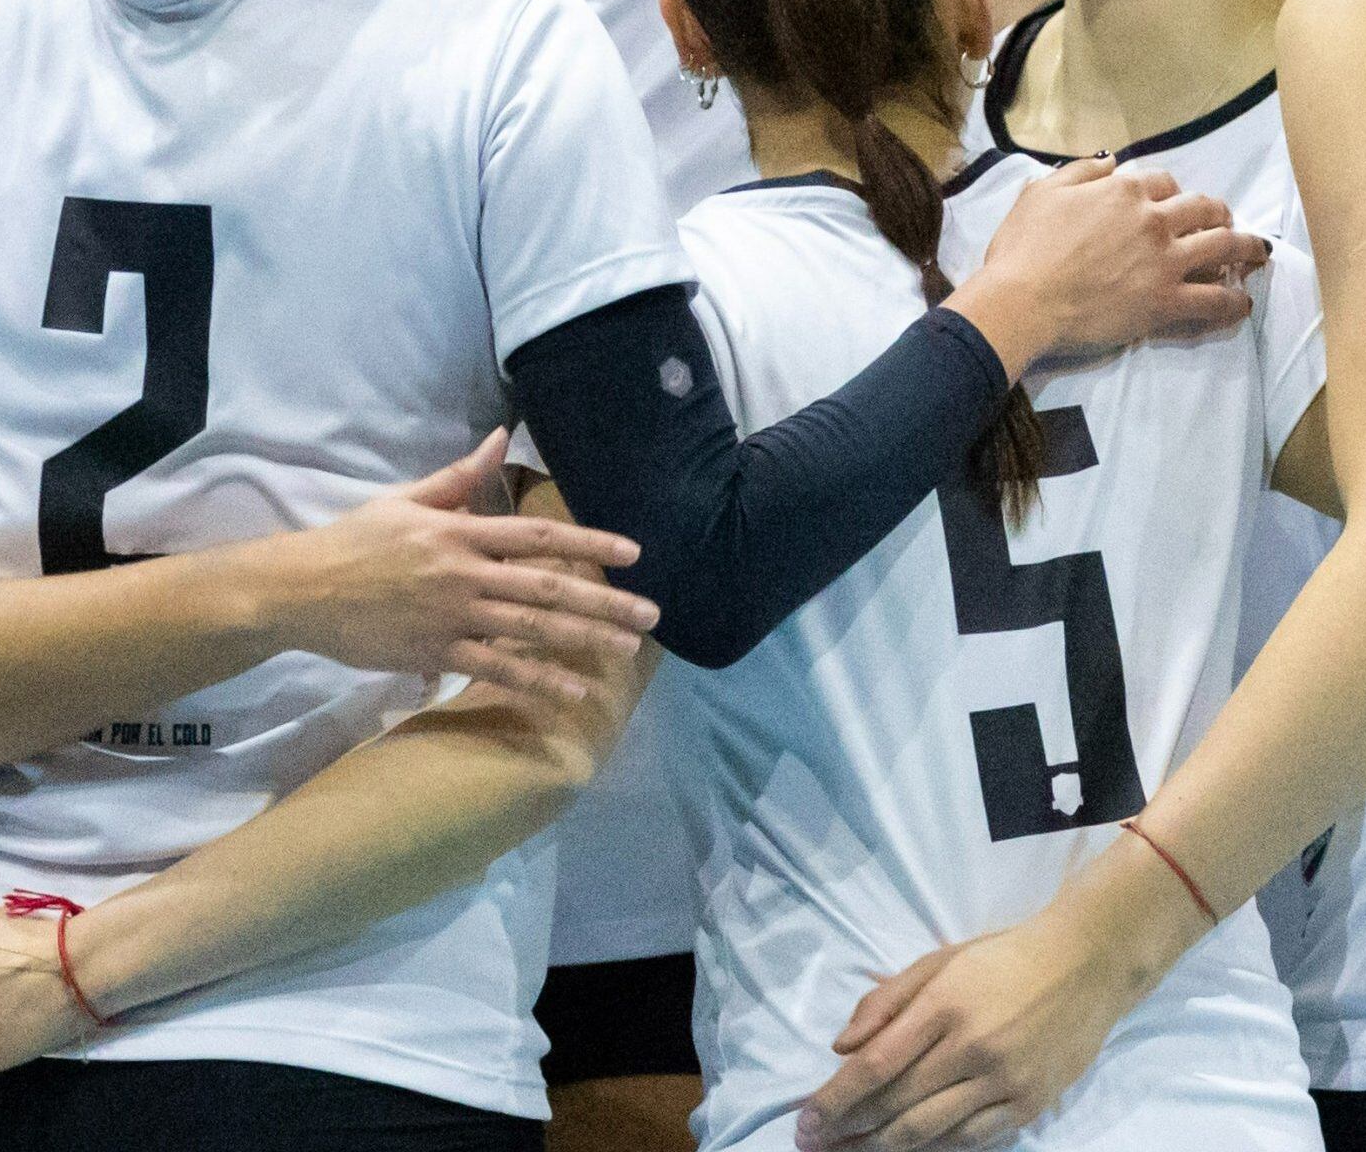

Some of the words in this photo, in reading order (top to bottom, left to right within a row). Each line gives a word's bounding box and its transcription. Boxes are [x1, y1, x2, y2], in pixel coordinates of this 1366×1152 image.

[38, 196, 214, 576] 2
[147, 722, 165, 747] EL
[171, 722, 212, 746] COLO
[935, 404, 1147, 842] 5
